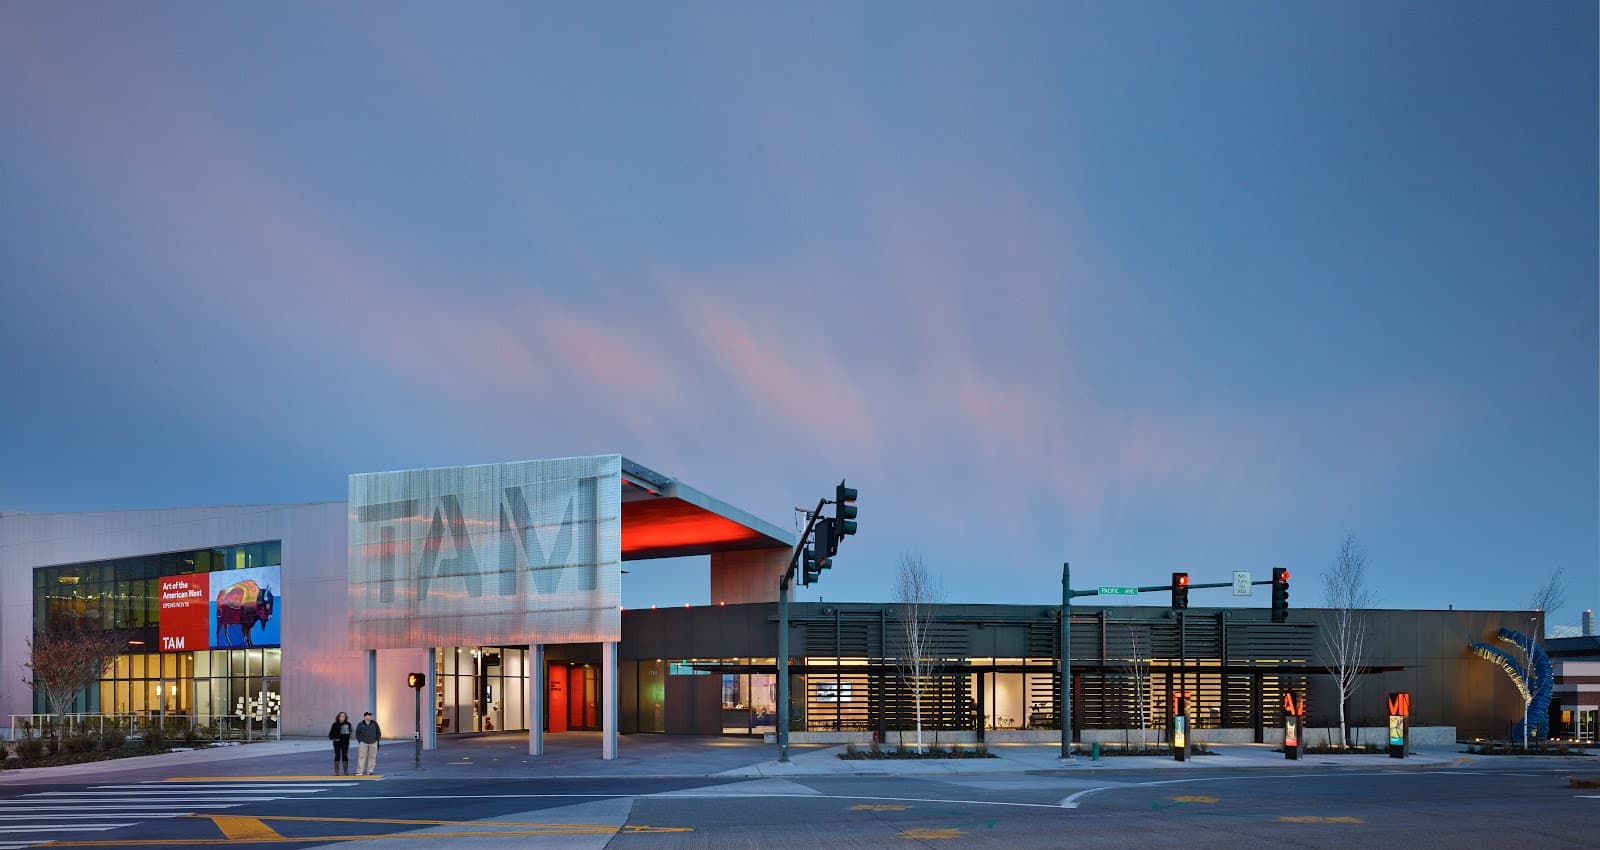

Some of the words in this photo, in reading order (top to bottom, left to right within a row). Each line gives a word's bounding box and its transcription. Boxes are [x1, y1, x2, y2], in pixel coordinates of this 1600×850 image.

[358, 477, 598, 603] TAM
[162, 582, 172, 590] Art
[172, 581, 178, 590] of
[178, 580, 188, 589] the
[162, 590, 188, 600] American
[162, 636, 184, 650] TAM
